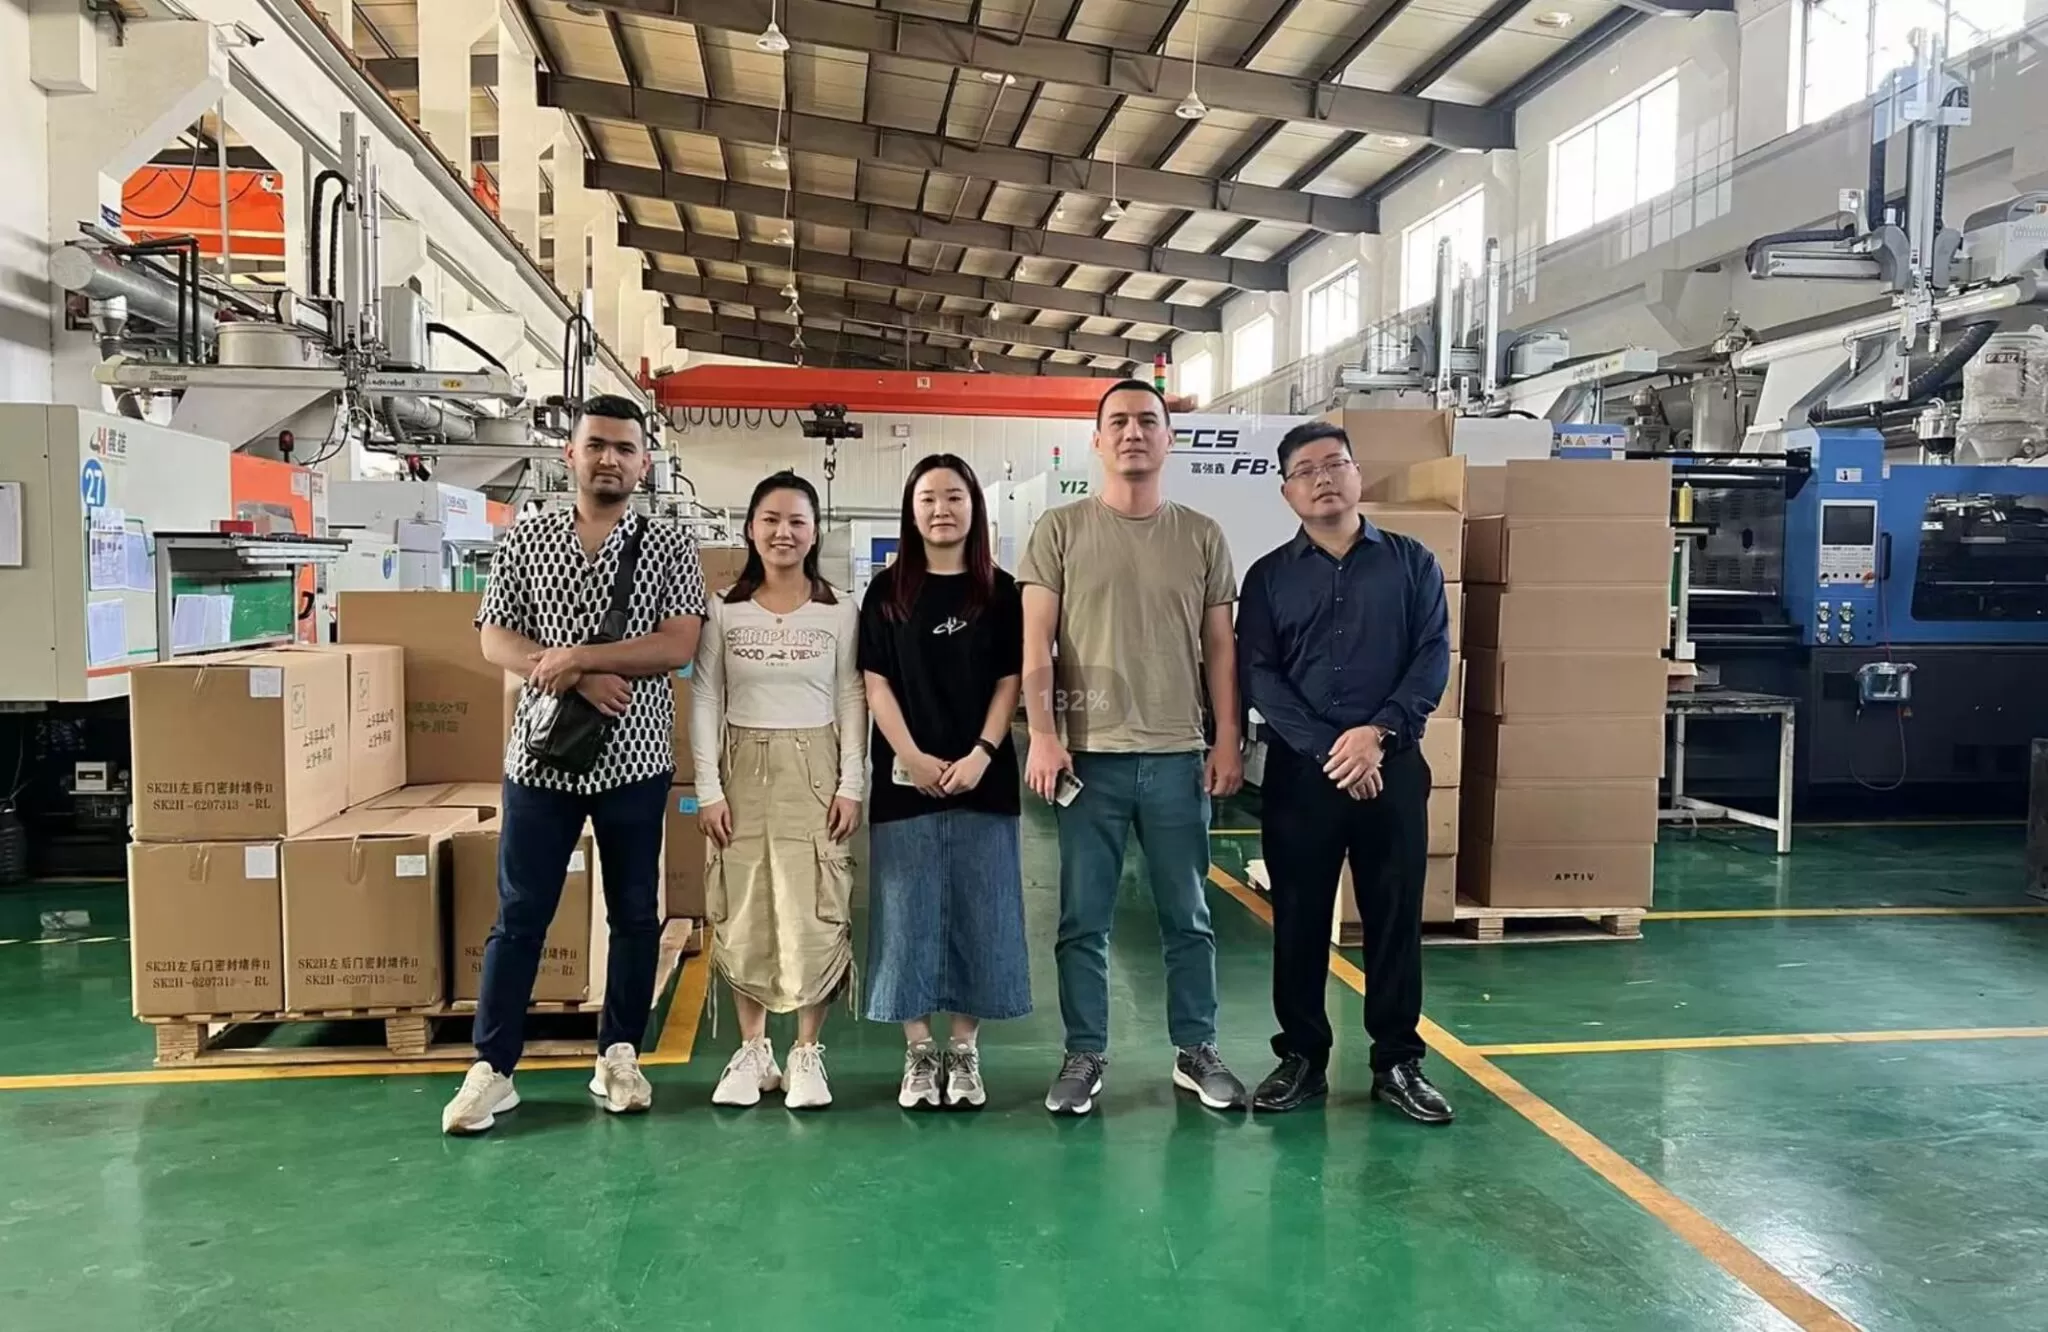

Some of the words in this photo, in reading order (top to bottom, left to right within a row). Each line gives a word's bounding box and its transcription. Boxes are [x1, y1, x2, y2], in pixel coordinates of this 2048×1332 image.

[1173, 429, 1239, 448] FCS
[1231, 458, 1283, 475] FB-
[85, 468, 103, 504] 27
[1060, 480, 1089, 494] YIZ
[1554, 872, 1595, 881] APTIV
